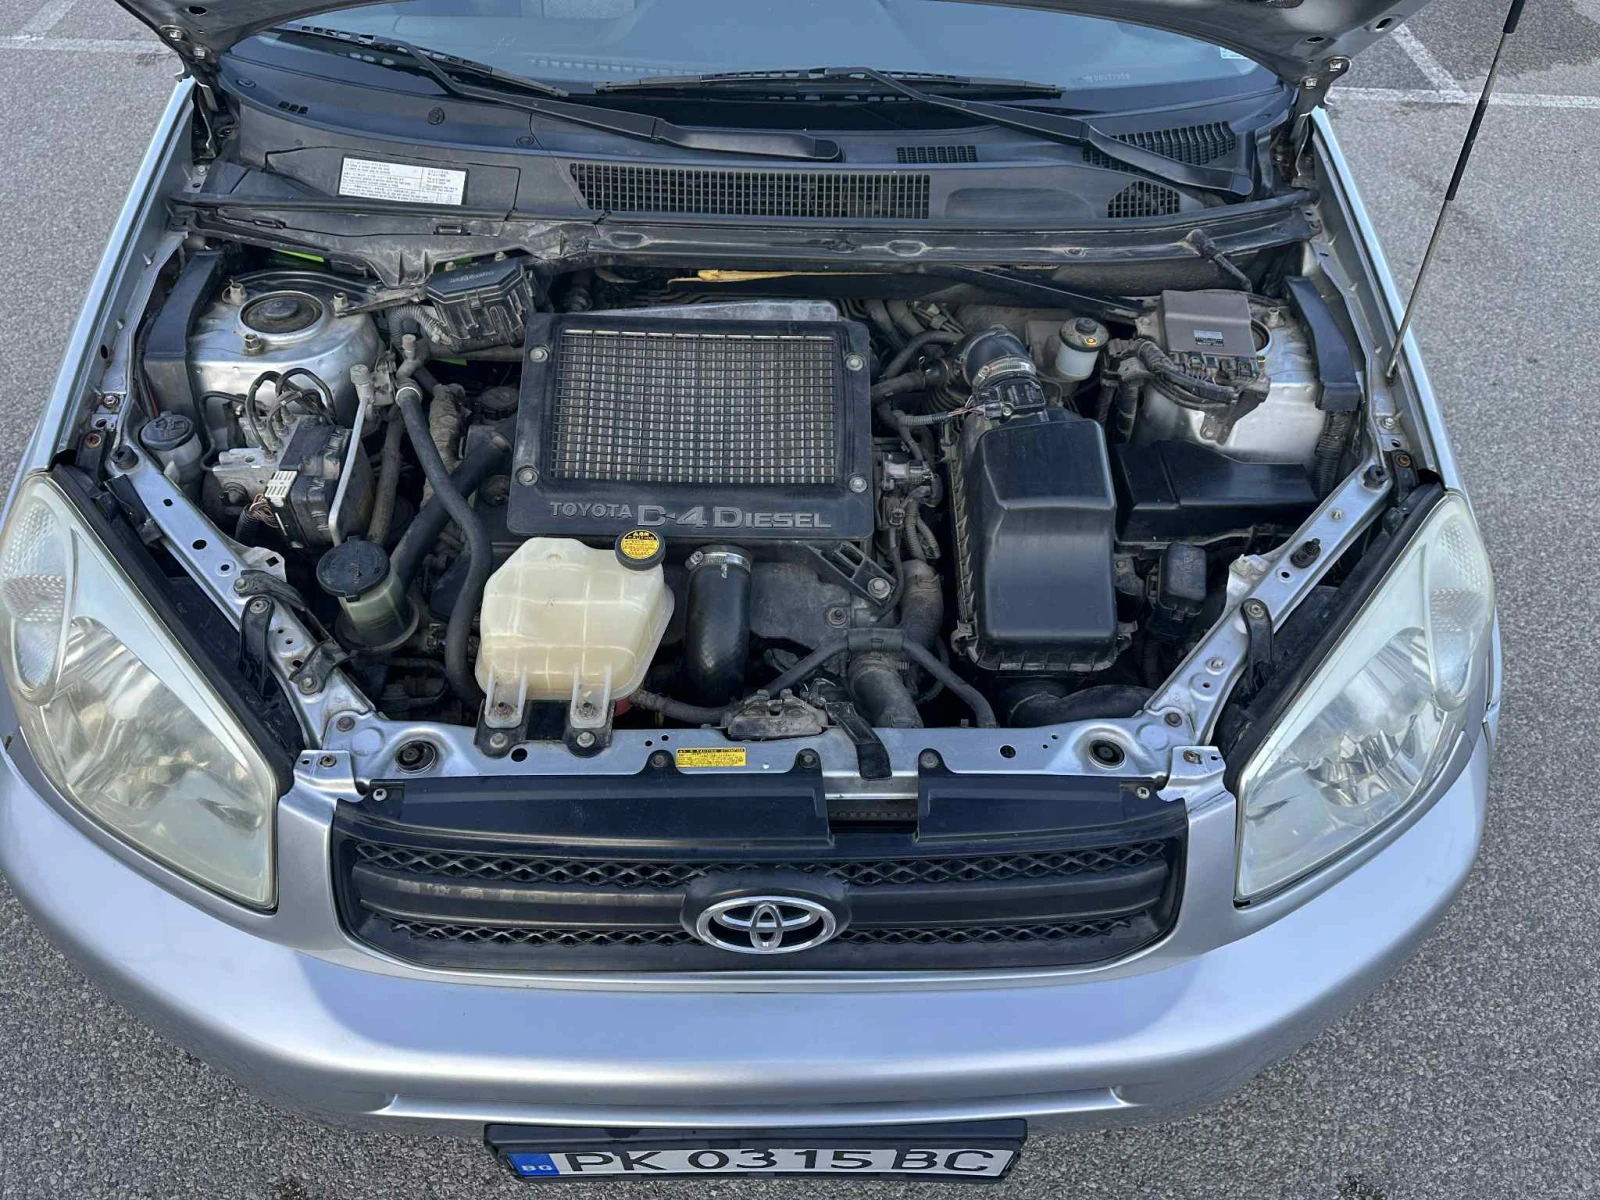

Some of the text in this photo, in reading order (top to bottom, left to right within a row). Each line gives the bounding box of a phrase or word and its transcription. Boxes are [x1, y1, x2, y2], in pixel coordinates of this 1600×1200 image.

[550, 501, 832, 529] TOYOTA D-4 DIESEL
[521, 1149, 994, 1172] BG PK 0315 BC
